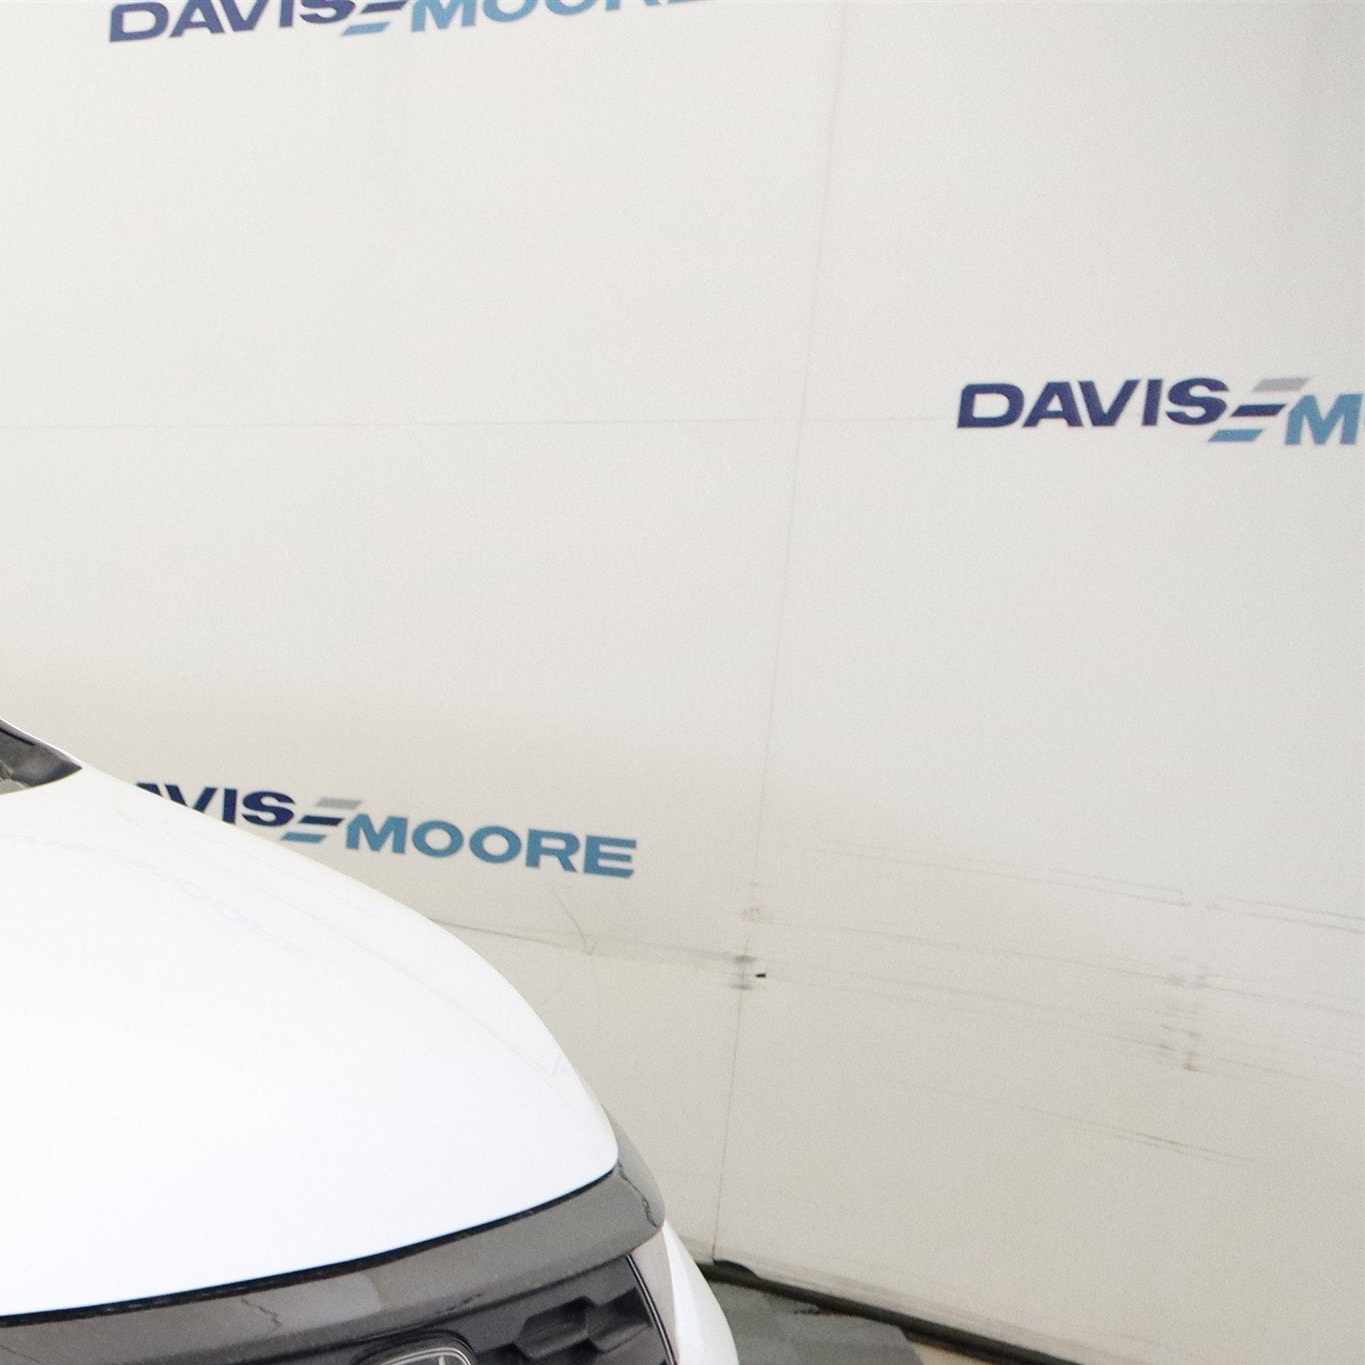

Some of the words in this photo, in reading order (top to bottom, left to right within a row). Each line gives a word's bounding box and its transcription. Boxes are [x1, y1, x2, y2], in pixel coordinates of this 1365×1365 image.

[108, 0, 357, 43] DAVIS
[956, 376, 1230, 430] DAVIS
[344, 812, 638, 880] MOORE
